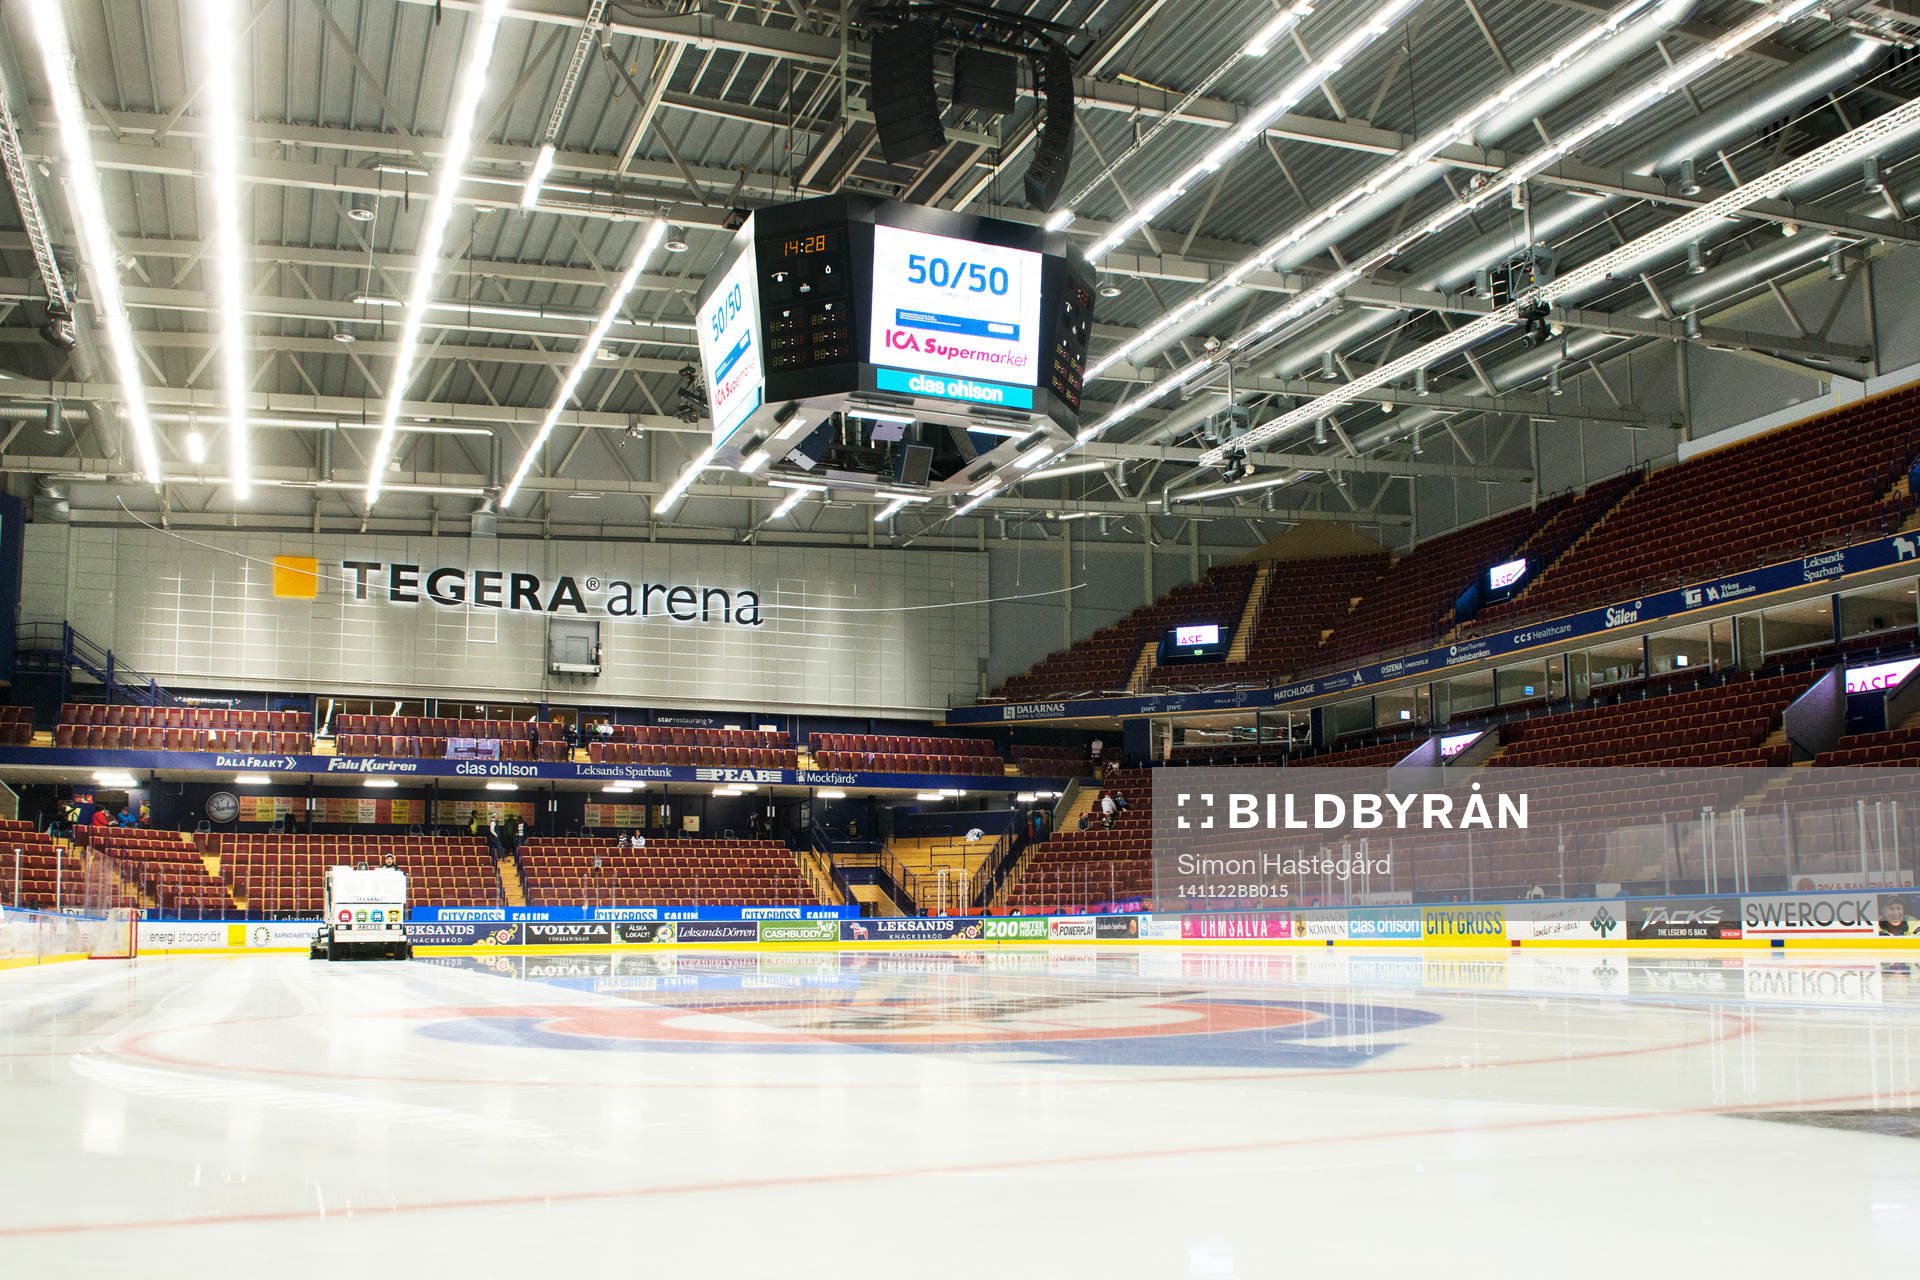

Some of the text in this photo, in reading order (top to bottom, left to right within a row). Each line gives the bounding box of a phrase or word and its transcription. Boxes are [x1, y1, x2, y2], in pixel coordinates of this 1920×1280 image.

[784, 235, 826, 257] 14:28
[908, 254, 1009, 296] 50/50
[711, 282, 742, 342] 50/50
[885, 328, 1029, 367] ICA Supermarket
[908, 374, 1003, 402] clas ohlson
[1803, 551, 1845, 570] Leksands
[1803, 565, 1845, 583] Sparbank
[606, 577, 763, 626] arena
[1605, 607, 1638, 628] Sälen
[1514, 623, 1572, 644] CCS Healthcare
[1446, 649, 1491, 665] Handelsbanken
[1273, 684, 1315, 701] MATCHLOGE
[1016, 703, 1065, 714] DALARNAS
[327, 757, 417, 772] Falu Kuriren
[456, 761, 539, 776] clas ohlson
[576, 764, 672, 779] Leksands Sparbank
[710, 768, 771, 783] PEAB
[1641, 905, 1724, 931] TACKS
[1746, 900, 1873, 927] SWEROCK
[405, 925, 475, 935] EKSANDS
[529, 925, 609, 935] VOLVIA
[877, 921, 954, 932] LEKSANDS
[986, 921, 1018, 937] 200
[1019, 921, 1045, 929] METER
[1058, 926, 1095, 936] POWERPLAY
[1200, 913, 1268, 938] ORMSALVA
[1309, 924, 1345, 935] KOMMUN
[1350, 913, 1420, 933] clas ohlson
[1425, 910, 1502, 936] CITY GROSS
[889, 932, 943, 940] KNÄCKEBRÖD
[1019, 928, 1048, 937] HOCKEY
